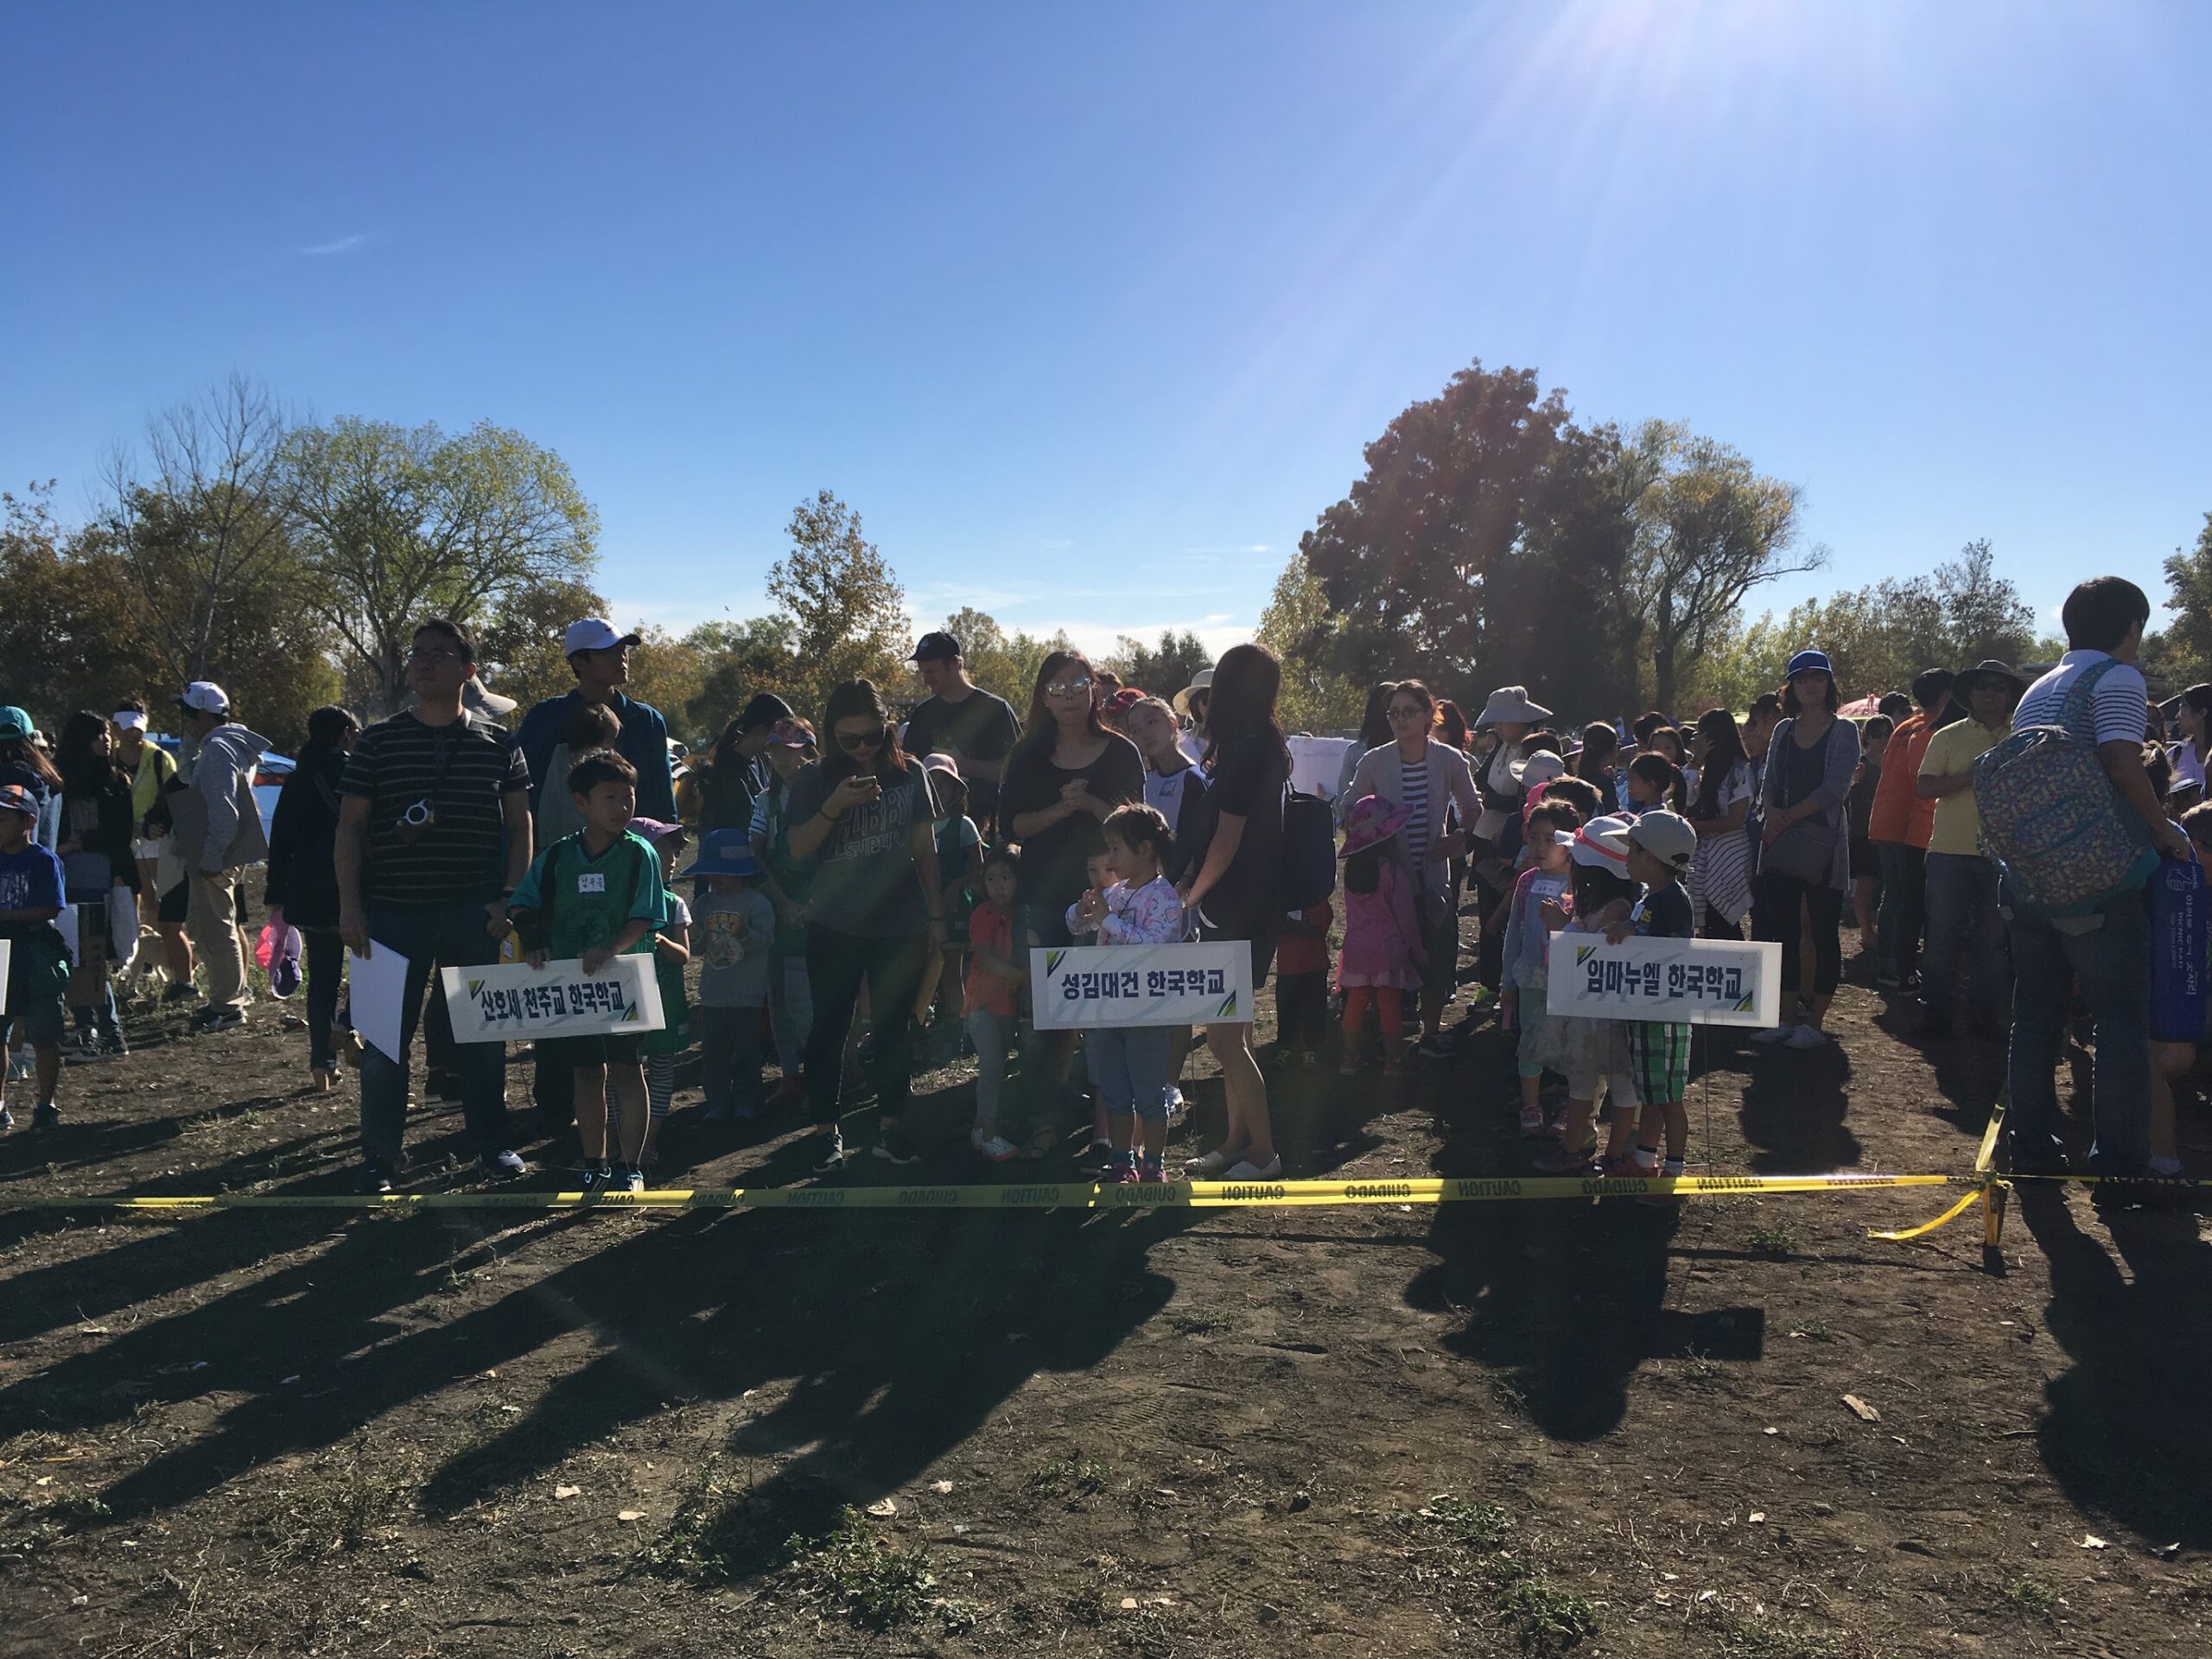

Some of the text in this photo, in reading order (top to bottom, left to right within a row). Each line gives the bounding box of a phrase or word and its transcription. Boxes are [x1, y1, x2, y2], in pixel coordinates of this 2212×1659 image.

[1061, 969, 1224, 1001] 성김대건 한국학교
[1586, 959, 1741, 1000] 임마누엘 한국학교
[480, 981, 625, 1021] 산호세 천주교 한국학교
